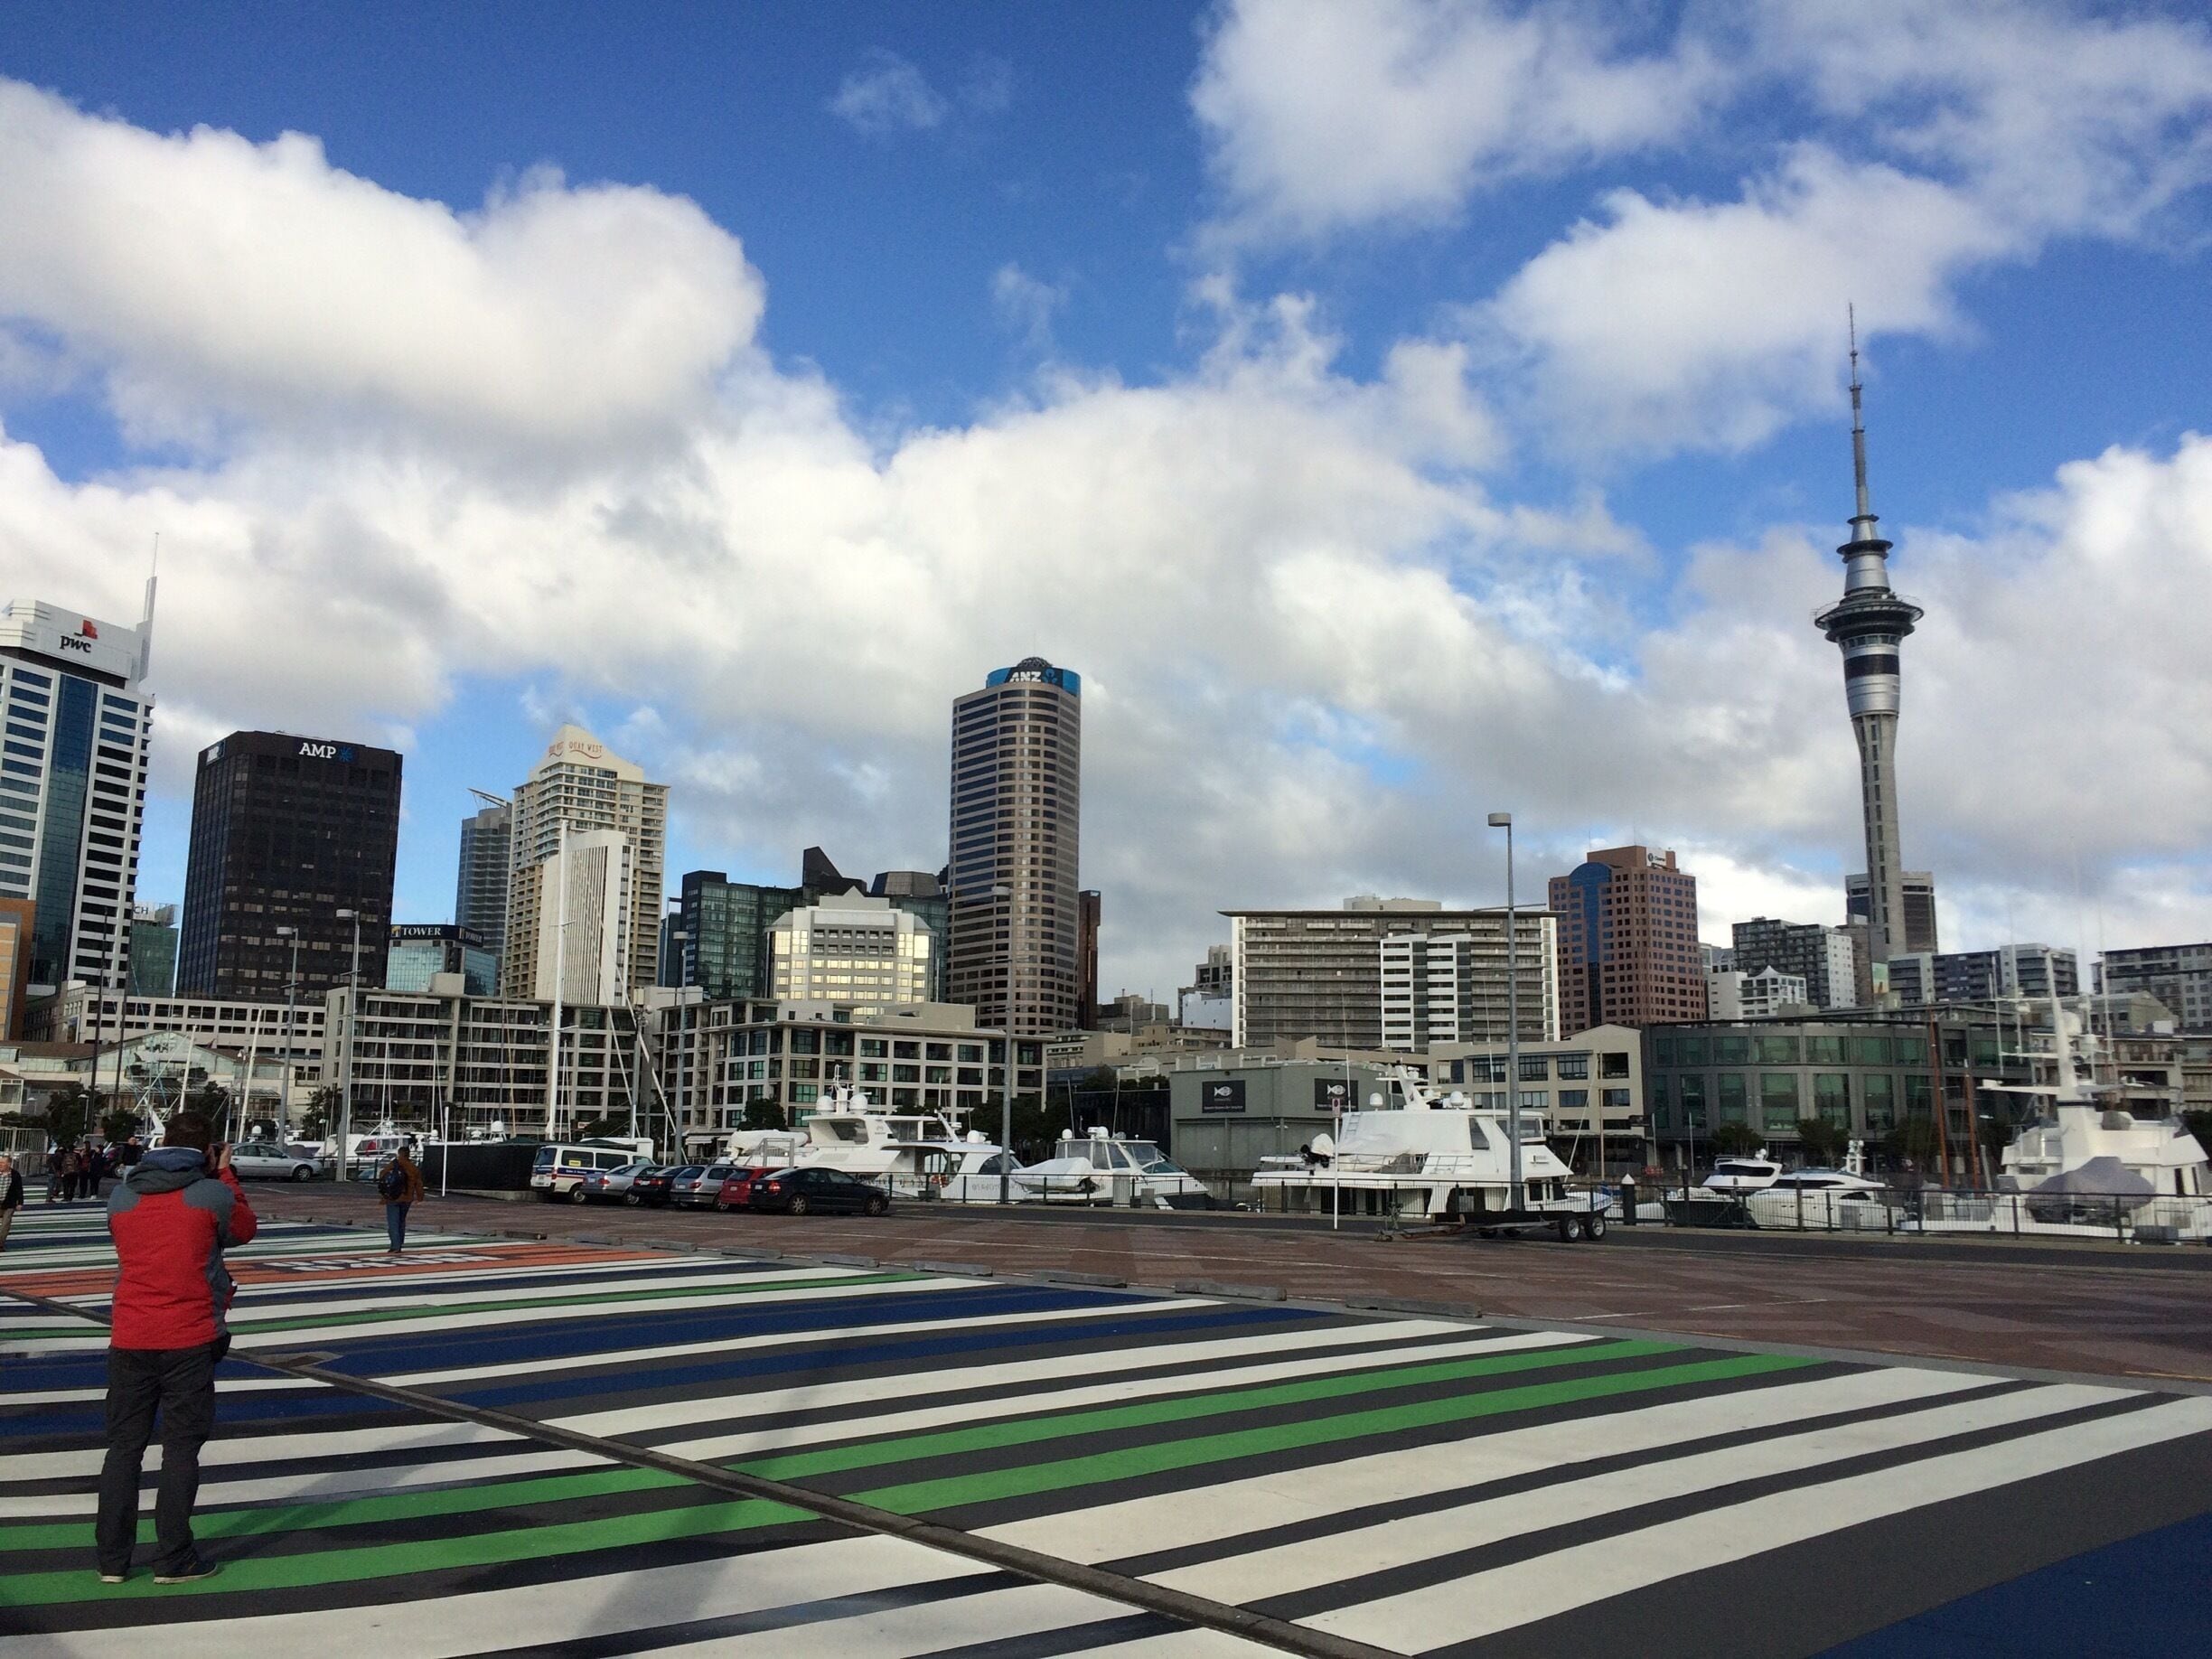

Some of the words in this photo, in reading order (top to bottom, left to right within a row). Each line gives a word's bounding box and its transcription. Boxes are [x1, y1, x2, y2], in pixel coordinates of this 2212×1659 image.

[59, 635, 92, 653] pwc
[1008, 670, 1042, 682] ANZ
[299, 742, 337, 759] AMP
[587, 743, 603, 753] WEST
[402, 927, 442, 936] TOWER
